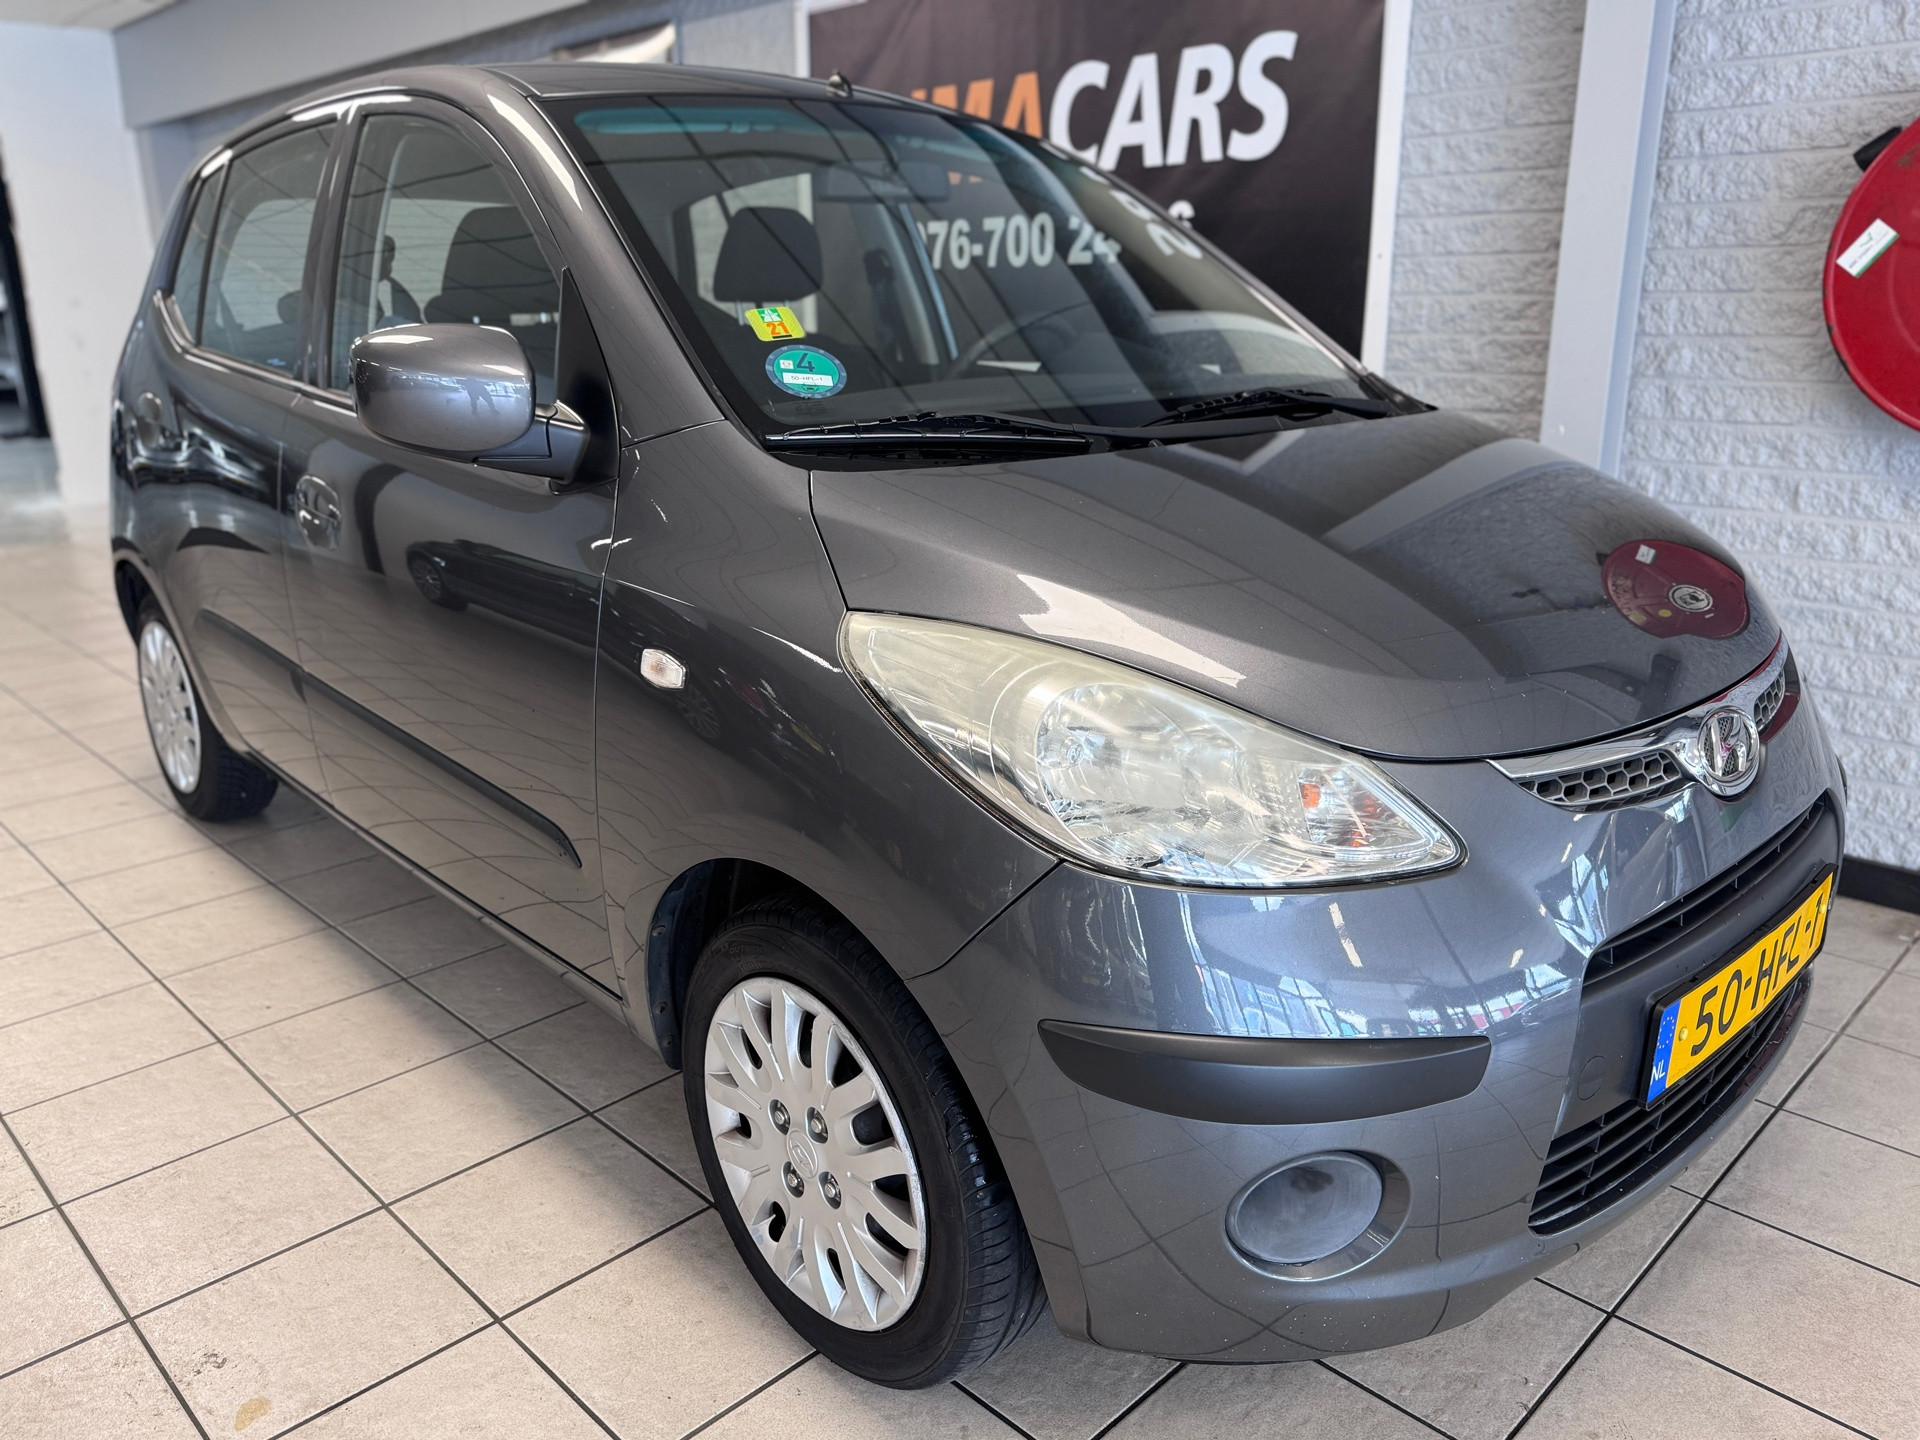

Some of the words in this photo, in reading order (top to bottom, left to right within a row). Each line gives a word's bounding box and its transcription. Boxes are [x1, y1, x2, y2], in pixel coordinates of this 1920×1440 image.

[766, 321, 790, 336] 21
[797, 353, 815, 372] 4
[1691, 892, 1824, 1057] 50-HFL-1
[1650, 1060, 1666, 1085] NL
